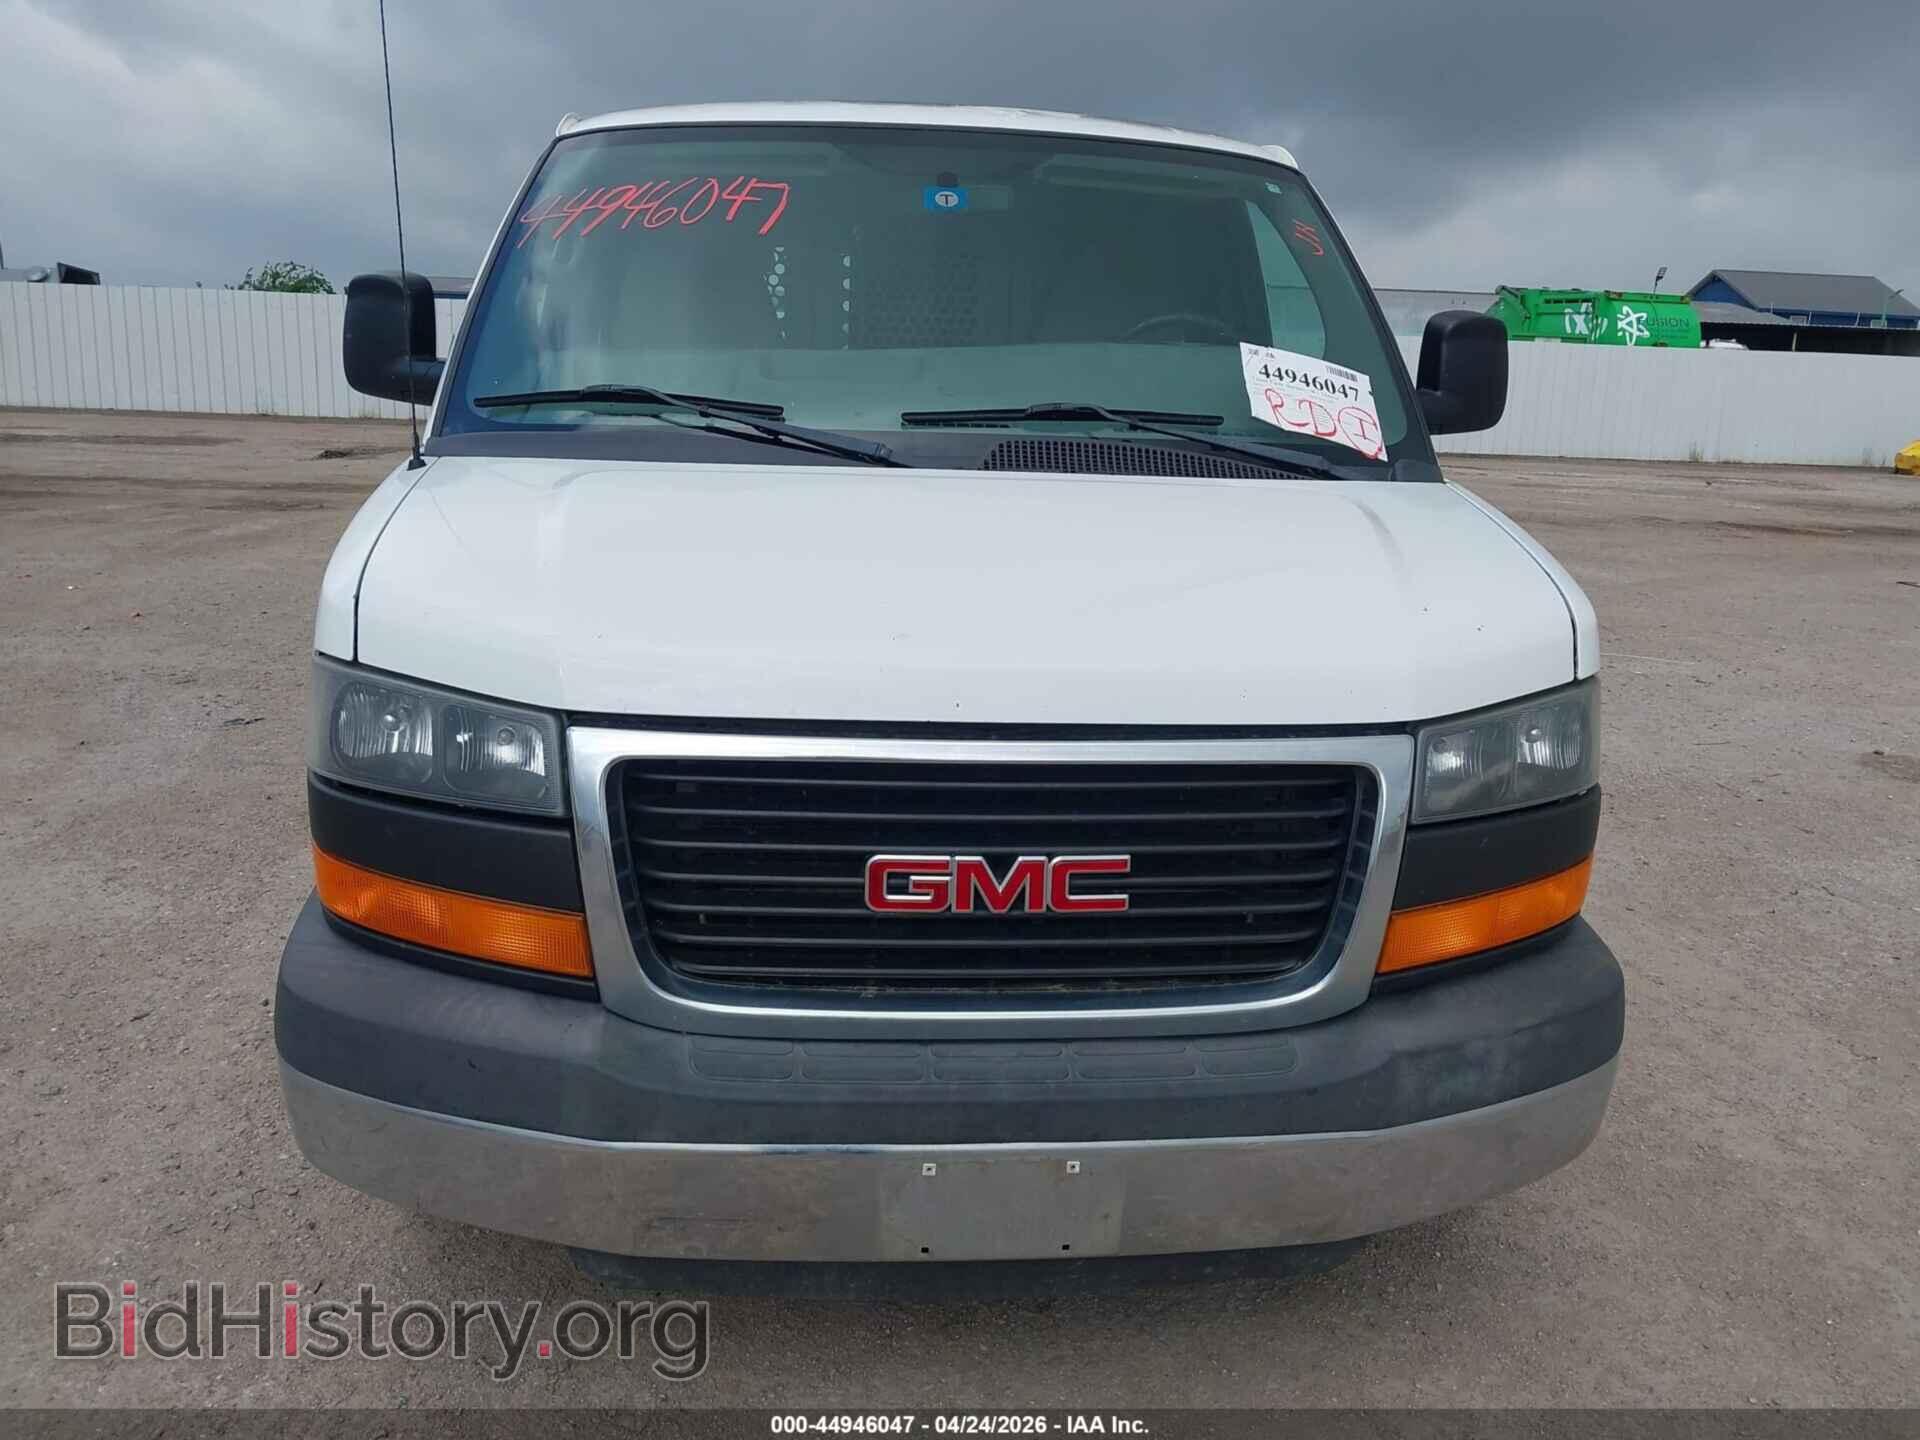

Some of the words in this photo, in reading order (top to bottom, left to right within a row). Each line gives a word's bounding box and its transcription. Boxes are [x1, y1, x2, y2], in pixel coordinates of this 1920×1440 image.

[518, 176, 790, 248] 44946047
[1258, 363, 1359, 402] 44946047
[865, 854, 1131, 913] GMC
